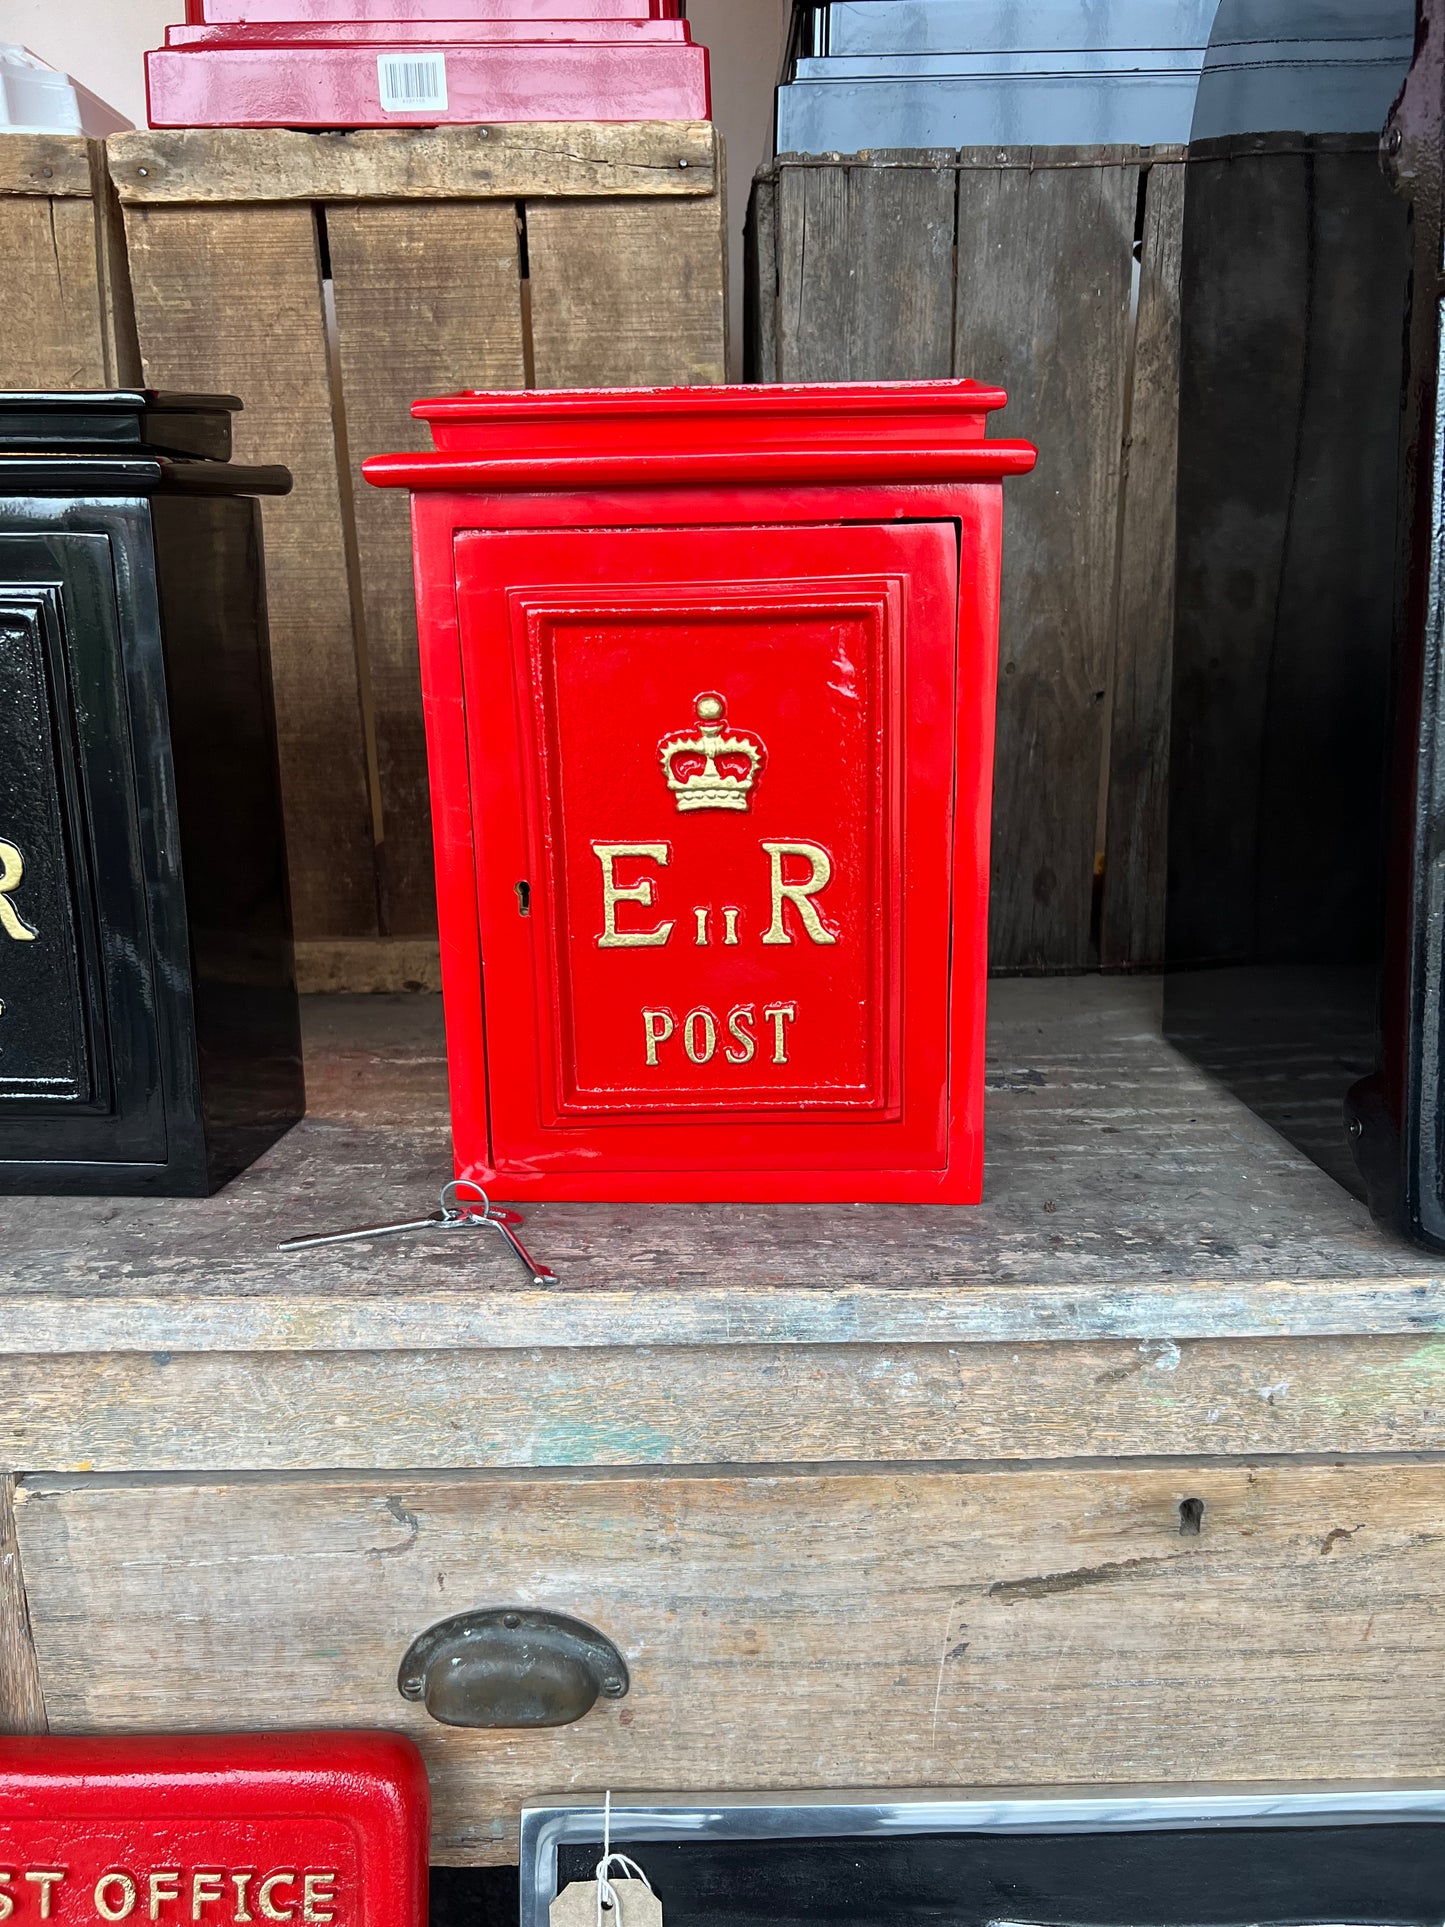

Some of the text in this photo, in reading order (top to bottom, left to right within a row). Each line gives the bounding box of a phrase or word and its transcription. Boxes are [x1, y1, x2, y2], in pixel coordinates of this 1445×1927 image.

[592, 843, 675, 948] E
[761, 842, 837, 945] R
[641, 1008, 796, 1066] POST
[93, 1871, 336, 1923] OFFICE
